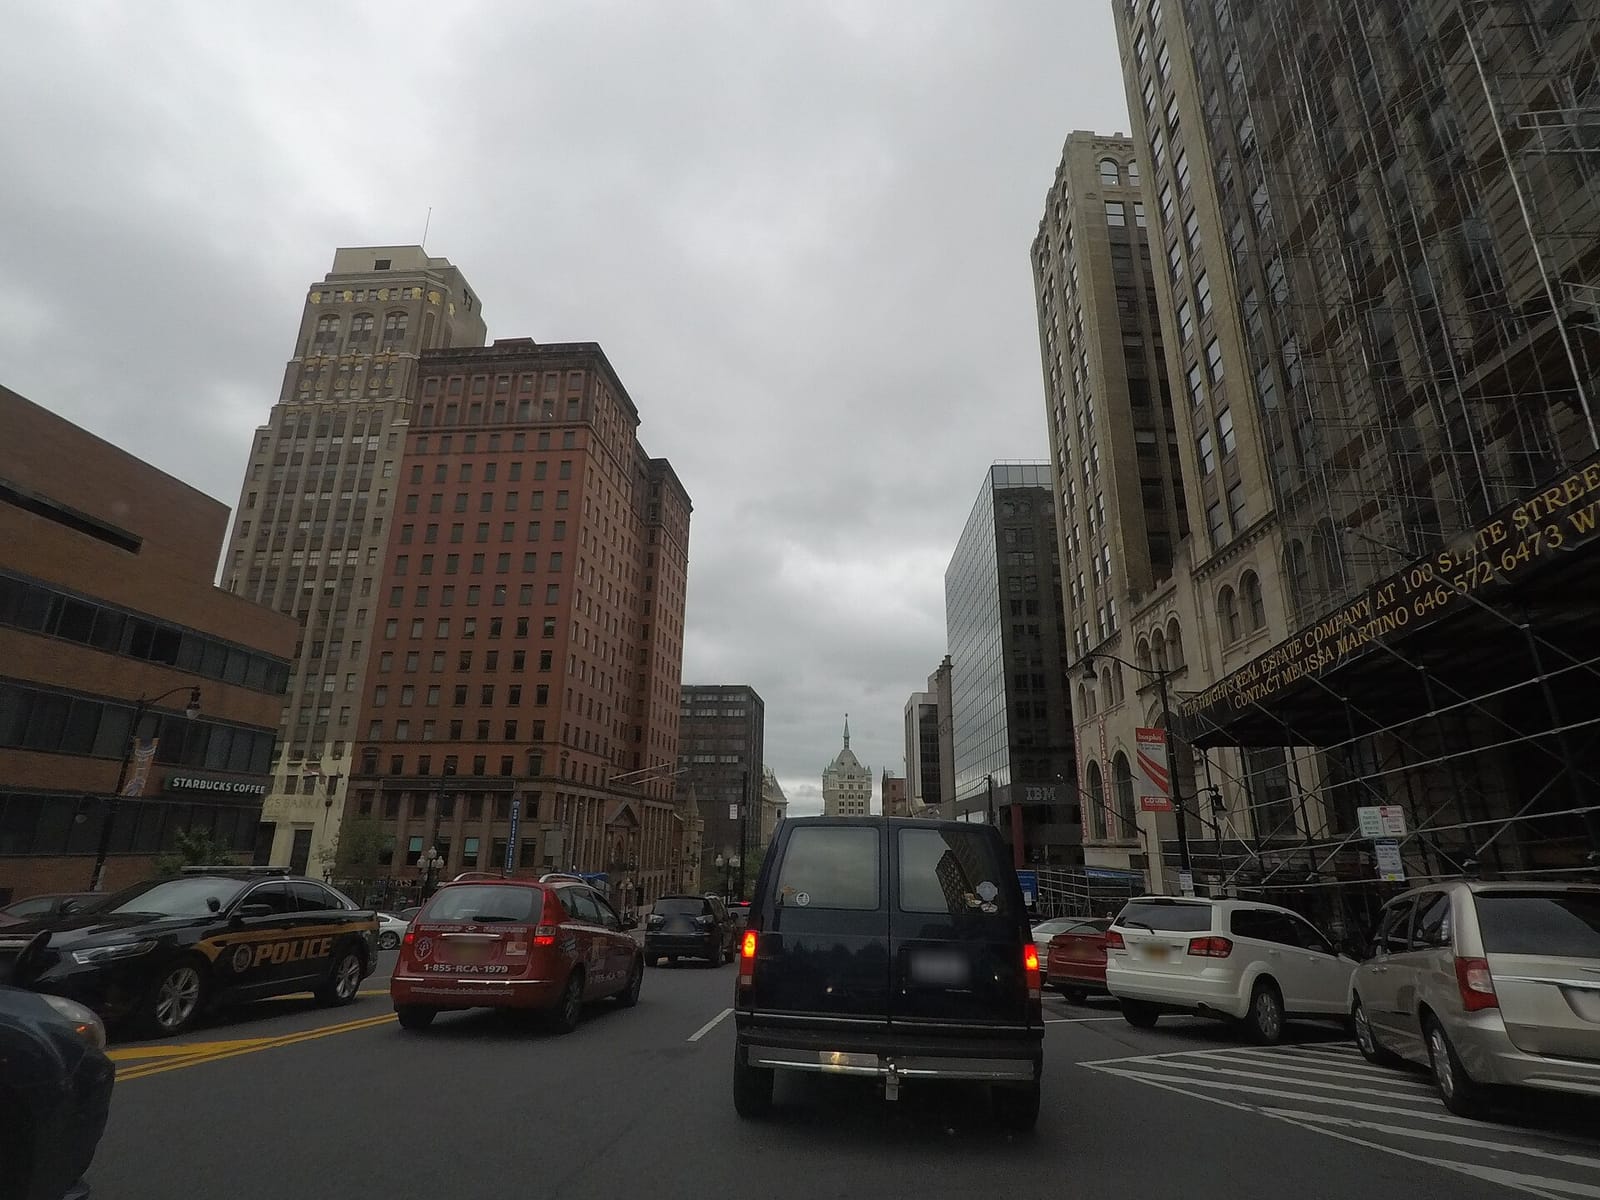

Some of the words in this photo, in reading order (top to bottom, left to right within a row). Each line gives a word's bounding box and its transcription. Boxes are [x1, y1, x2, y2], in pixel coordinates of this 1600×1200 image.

[1235, 663, 1261, 690] REAL
[1261, 638, 1304, 673] ESTATE
[1304, 596, 1371, 648] COMPANY
[1375, 584, 1397, 611] AT
[1402, 562, 1435, 595] 100
[1437, 519, 1507, 574] STATE
[1234, 675, 1281, 710] CONTACT
[1281, 648, 1336, 687] MELISSA
[1336, 605, 1409, 658] MARTINO
[1413, 524, 1564, 617] 646-572-6473
[172, 777, 232, 792] STARBUCKS
[233, 783, 266, 794] COFFEE
[1025, 786, 1057, 801] IBM
[253, 937, 333, 967] POLICE
[423, 963, 509, 974] 1-855-RCA-1979
